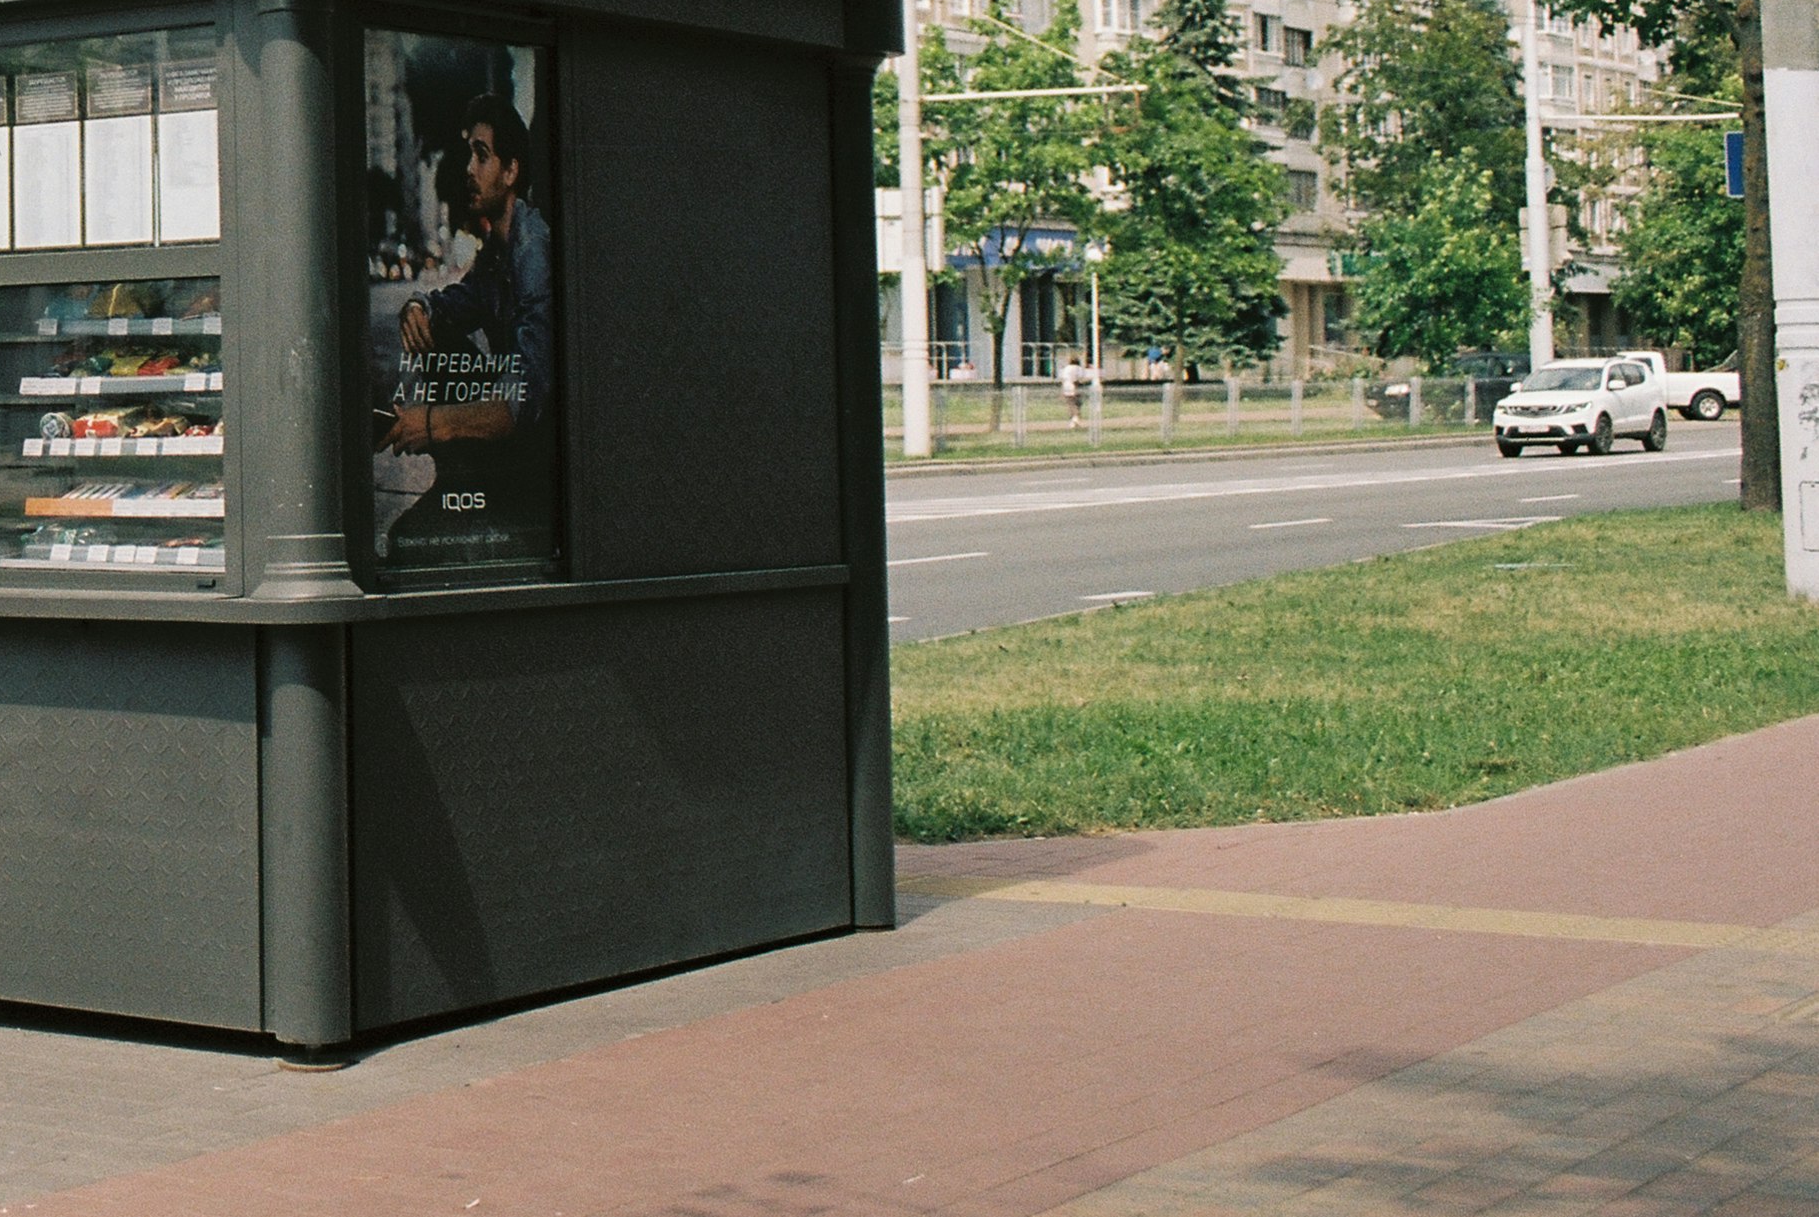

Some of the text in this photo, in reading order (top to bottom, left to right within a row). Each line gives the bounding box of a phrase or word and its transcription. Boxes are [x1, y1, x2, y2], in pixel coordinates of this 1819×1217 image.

[398, 352, 525, 374] НАГРЕВАНИЕ,
[392, 382, 528, 402] А НЕ ГОРЕНИЕ
[442, 492, 486, 512] IQOS
